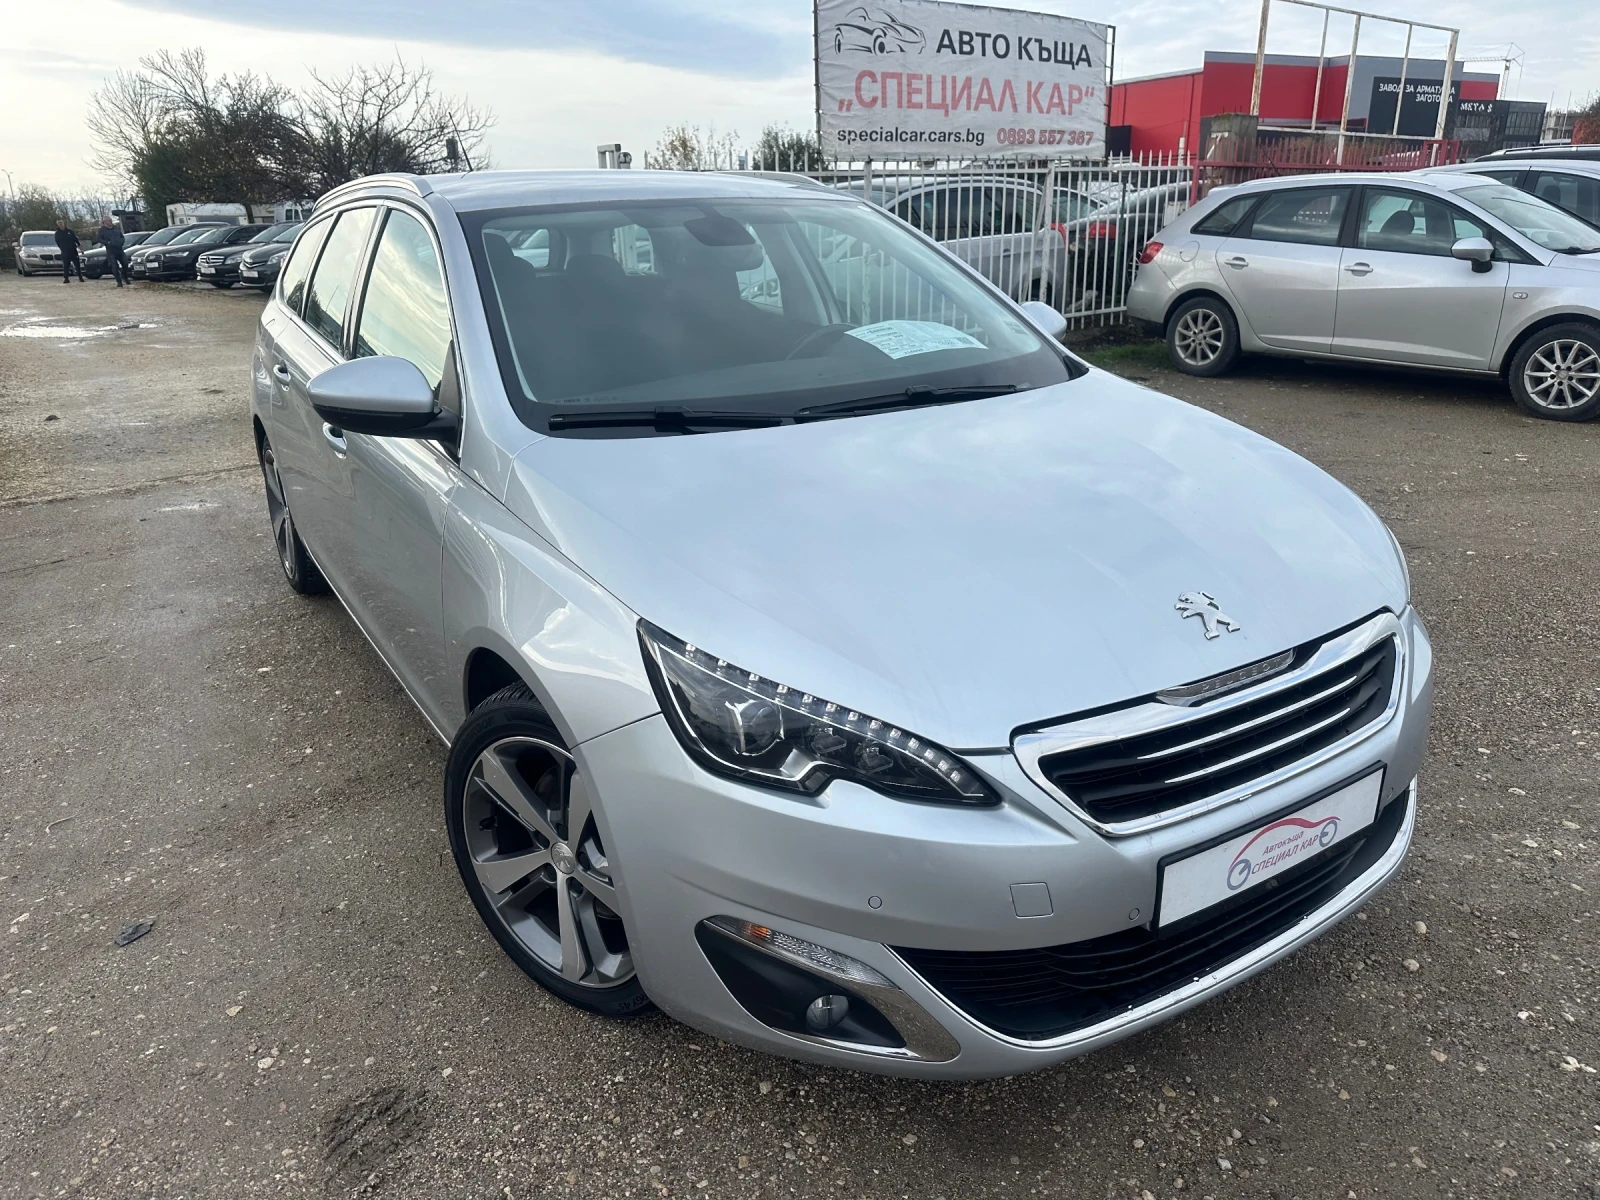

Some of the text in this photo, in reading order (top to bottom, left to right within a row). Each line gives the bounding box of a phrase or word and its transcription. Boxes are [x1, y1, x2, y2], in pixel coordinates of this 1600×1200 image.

[936, 29, 1093, 70] АВТО КЪЩА
[1405, 84, 1415, 93] ЗА
[1416, 84, 1456, 95] АРМАТУА
[1415, 93, 1453, 103] ЗАГОТОА
[837, 127, 985, 146] specialcar.cars.bg
[996, 127, 1036, 145] 0893
[1038, 129, 1066, 145] 557
[1262, 831, 1305, 856] Автокъща
[1252, 834, 1320, 875] СПЕЦИАЛ КАР
